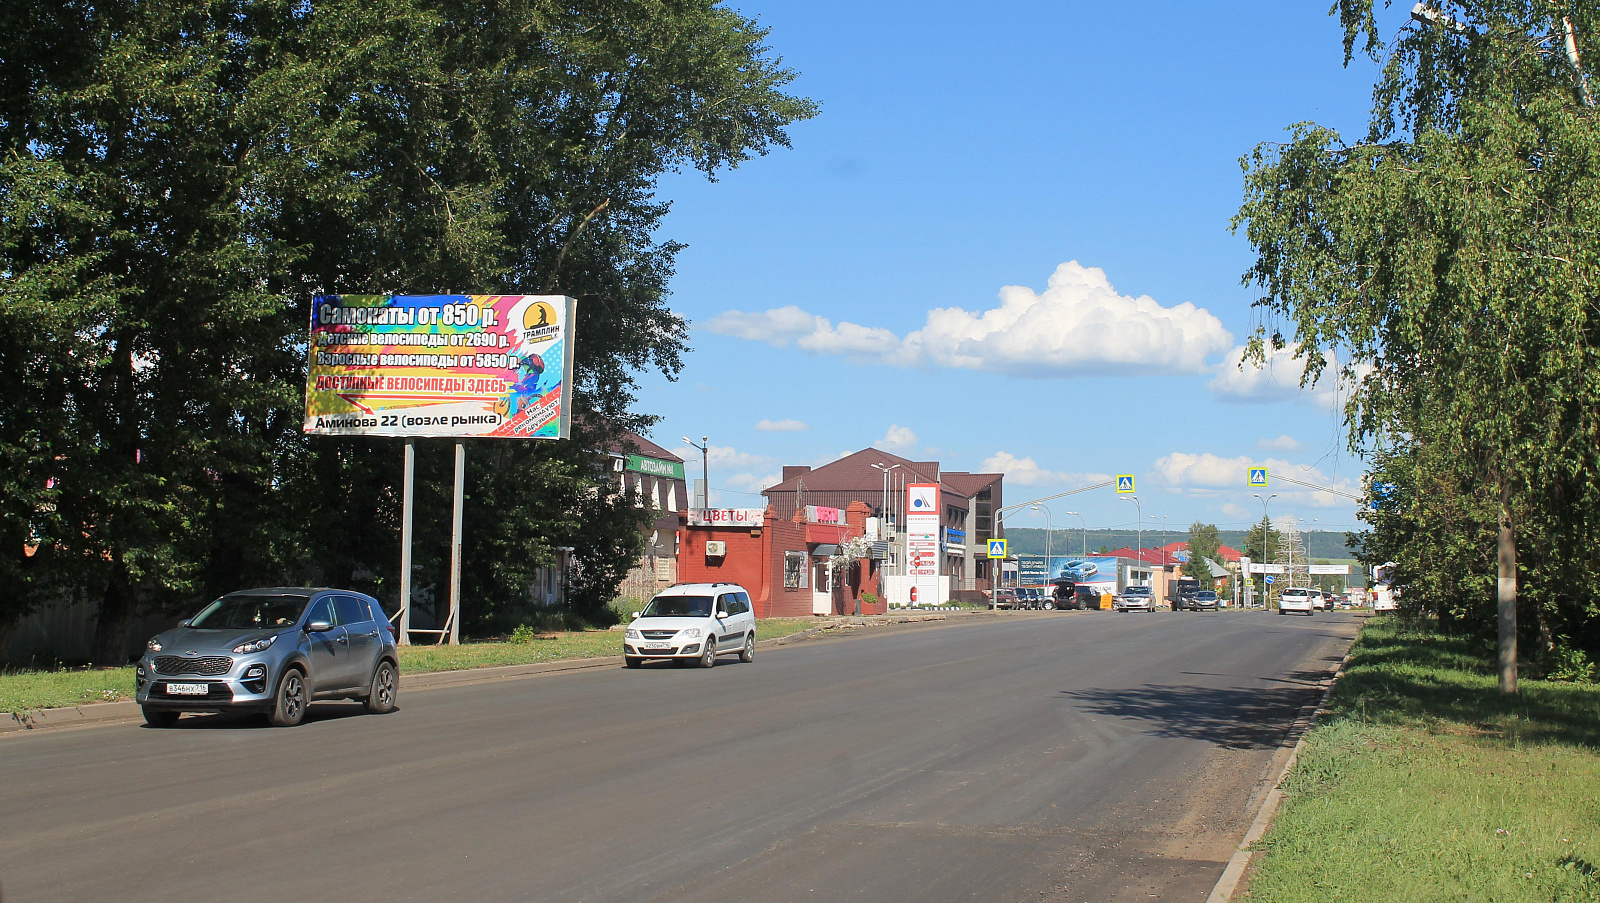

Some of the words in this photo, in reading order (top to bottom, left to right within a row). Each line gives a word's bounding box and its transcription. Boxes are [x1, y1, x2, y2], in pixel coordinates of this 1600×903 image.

[320, 304, 415, 325] Самокаты
[417, 307, 439, 325] от
[442, 303, 479, 326] 850
[482, 307, 499, 328] р.
[523, 325, 560, 339] ТРАМПЛИН
[317, 332, 369, 346] Детские
[370, 333, 448, 348] велосипеды
[450, 334, 465, 346] от
[465, 332, 497, 347] 2690
[498, 334, 510, 348] р.
[317, 352, 379, 366] Взрослые
[380, 354, 458, 368] велосипеды
[460, 355, 475, 367] от
[475, 354, 508, 368] 5850
[508, 355, 520, 369] р.
[315, 376, 385, 391] ДОСТУПНЫЕ
[387, 377, 466, 393] ВЕЛОСИПЕДЫ
[468, 379, 507, 394] ЗДЕСЬ
[526, 404, 540, 416] Нас
[315, 417, 377, 428] Аминова
[380, 415, 398, 427] 22
[401, 415, 448, 428] (возле
[451, 413, 502, 428] рынка)
[702, 510, 747, 523] ЦВЕТЫ
